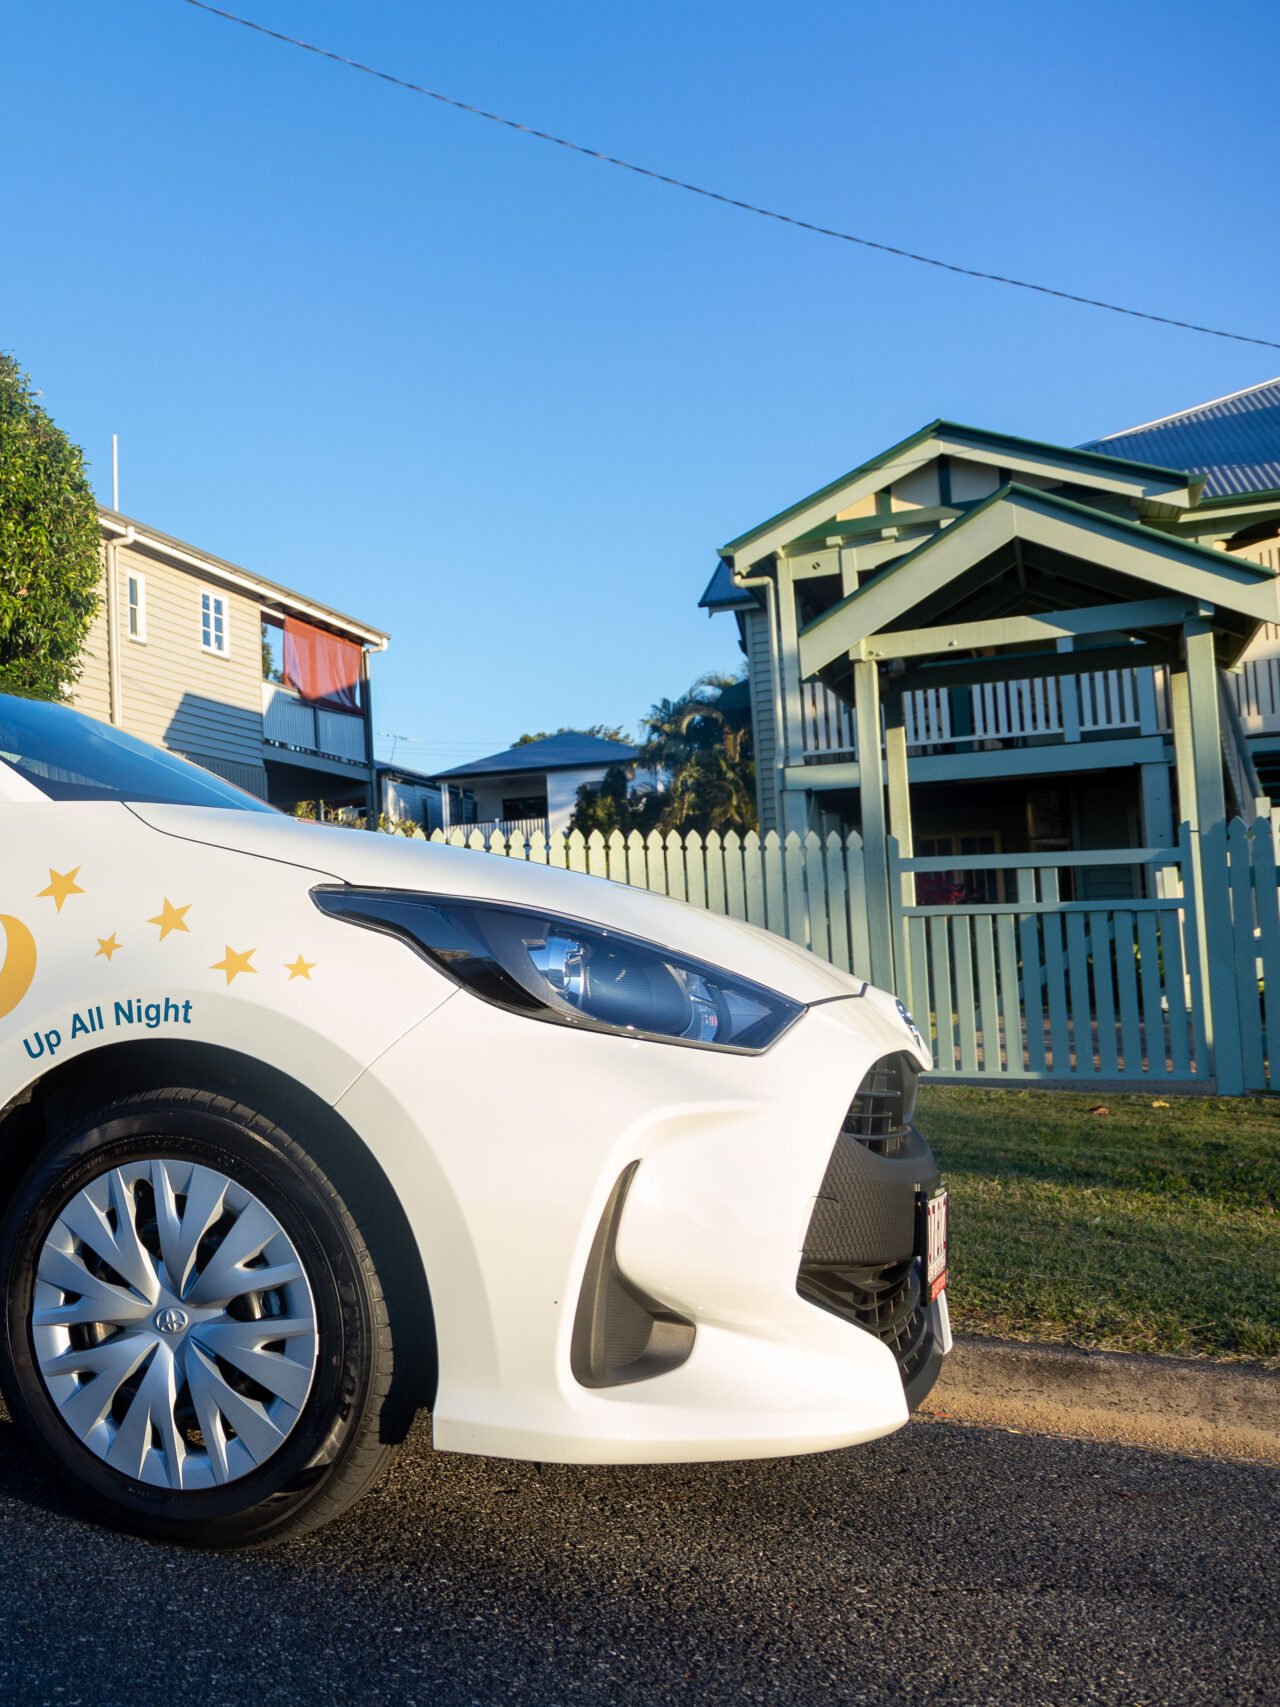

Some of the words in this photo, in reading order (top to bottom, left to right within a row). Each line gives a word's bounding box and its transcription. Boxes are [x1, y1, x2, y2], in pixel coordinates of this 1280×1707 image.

[23, 1029, 62, 1060] Up
[71, 1006, 105, 1040] All
[114, 997, 192, 1029] Night
